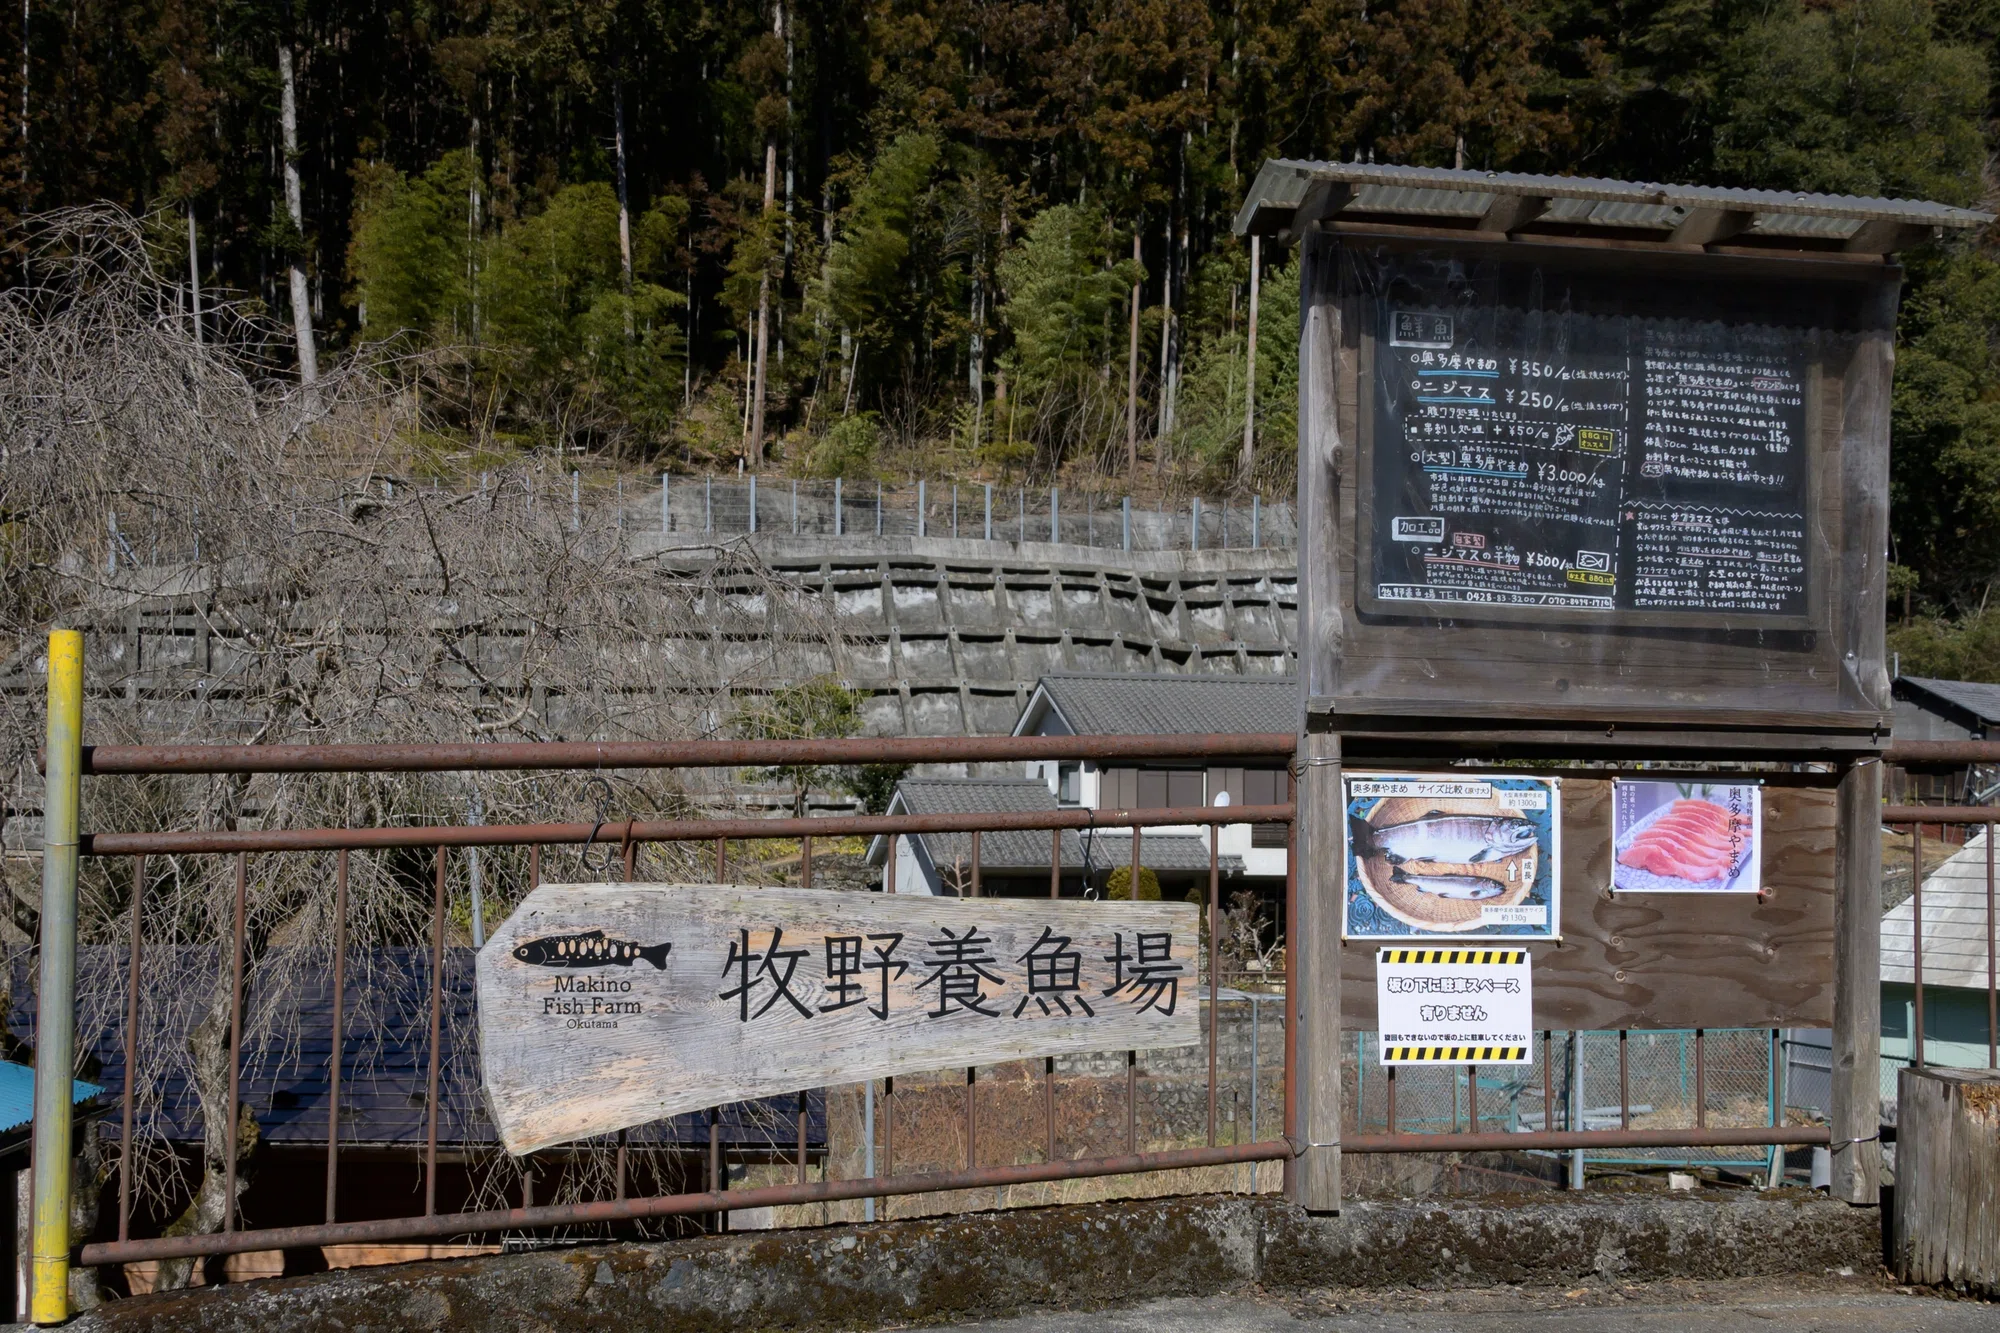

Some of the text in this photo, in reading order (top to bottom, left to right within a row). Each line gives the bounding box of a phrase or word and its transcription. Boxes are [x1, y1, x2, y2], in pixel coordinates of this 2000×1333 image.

[1421, 350, 1498, 370] 奥多摩やまめ
[1423, 380, 1490, 400] ニジマス
[1423, 422, 1485, 436] 串刺し処理
[1400, 520, 1441, 535] 加工品
[1423, 546, 1520, 566] ニジマスの干物
[1439, 591, 1462, 601] TEL
[1466, 591, 1536, 604] 0428-83-3200
[1353, 783, 1408, 794] 奥多摩やまめ
[1728, 787, 1742, 878] 奥多摩やまめ
[1524, 863, 1532, 880] 成長
[719, 925, 1185, 1022] 牧野養魚場
[554, 975, 632, 993] Makino
[1387, 977, 1521, 994] 坂の下に駐車スペース
[543, 996, 642, 1015] Fish Farm
[1420, 1004, 1488, 1022] 有りません
[566, 1018, 618, 1029] Okutama
